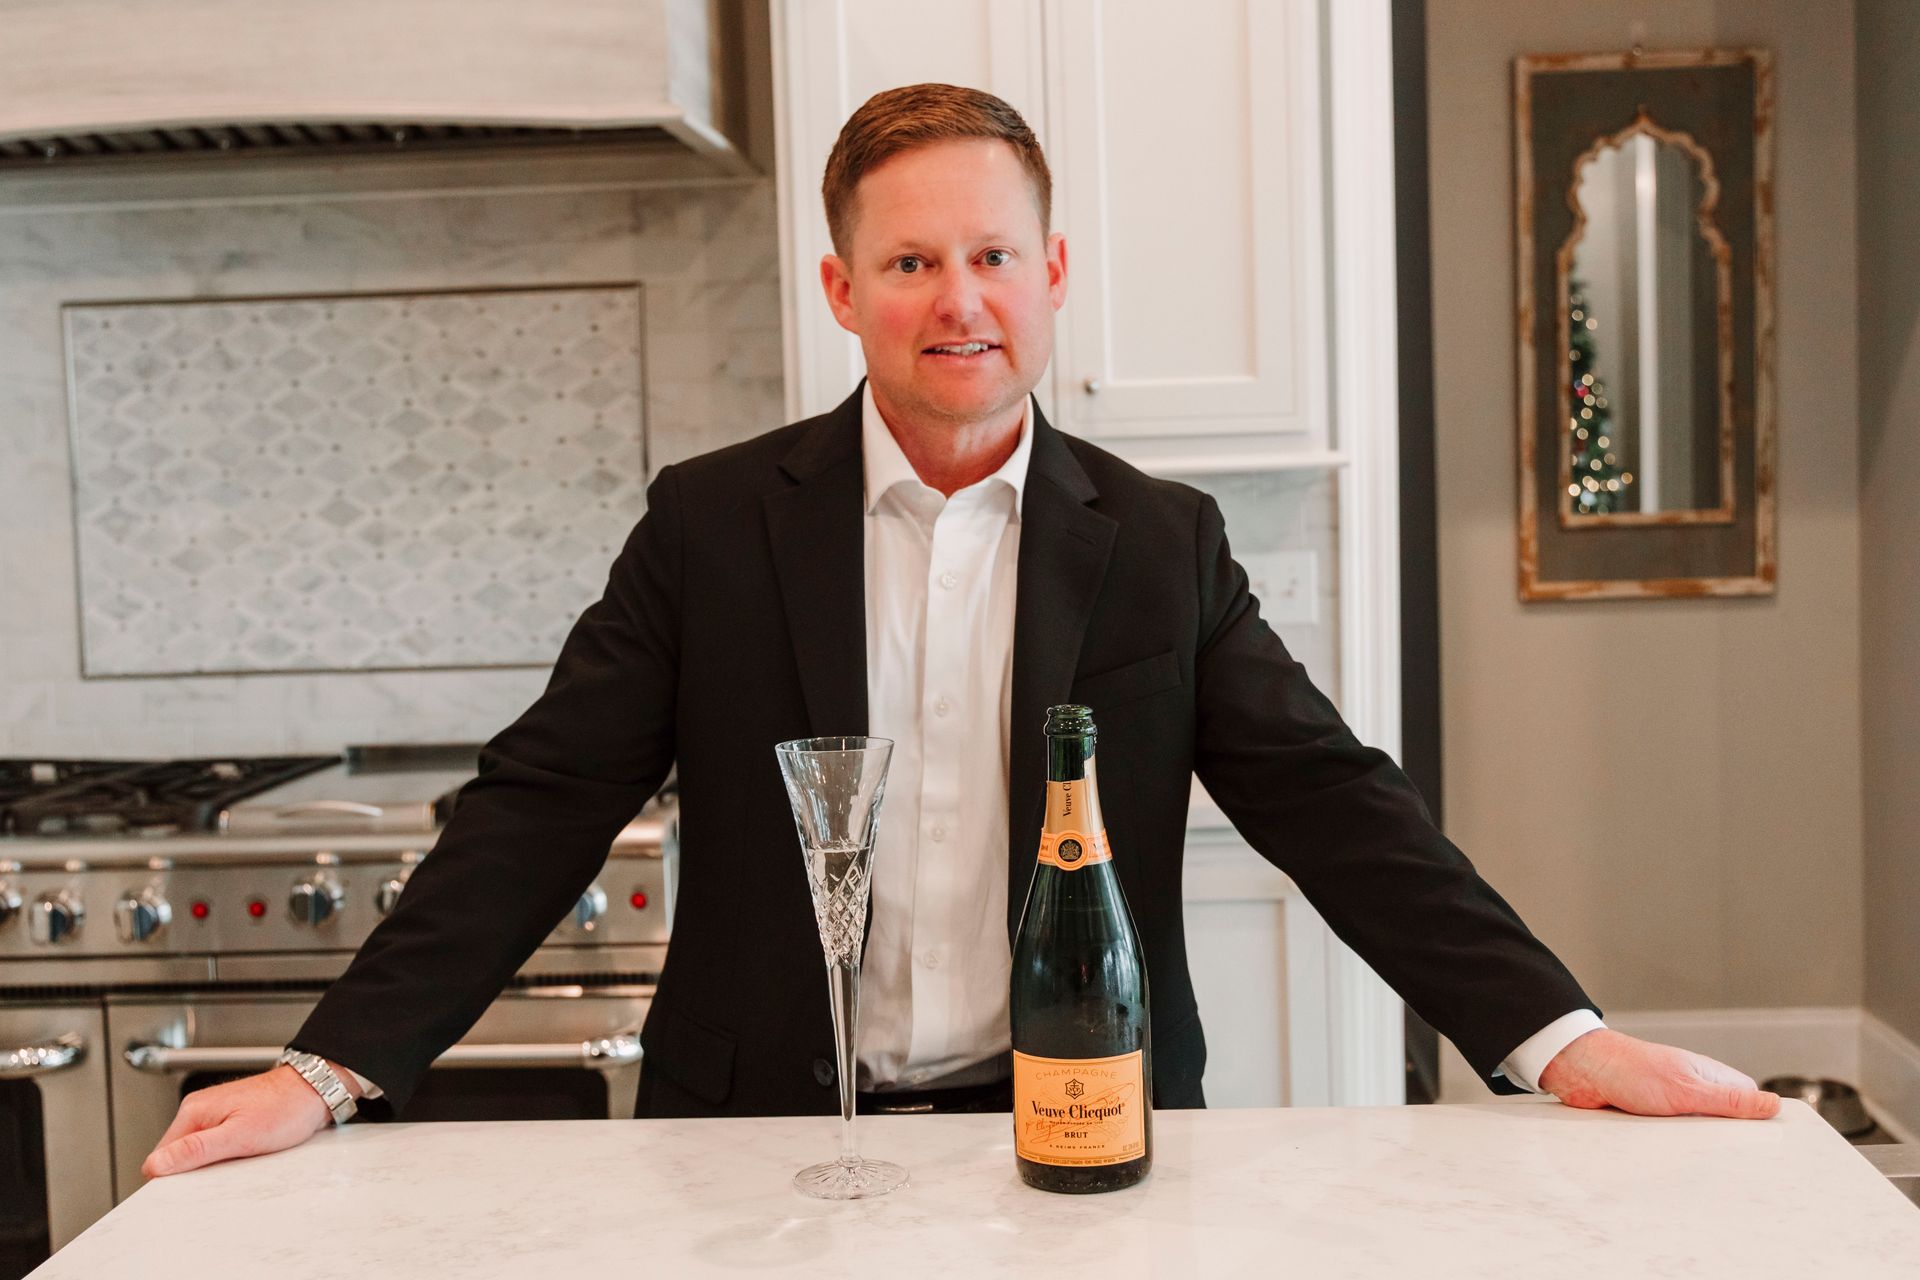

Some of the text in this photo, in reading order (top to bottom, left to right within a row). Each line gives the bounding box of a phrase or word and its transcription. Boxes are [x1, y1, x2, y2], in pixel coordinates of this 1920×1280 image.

[1063, 792, 1072, 817] Veuve
[1035, 1067, 1119, 1080] CHAMPAGNE
[1032, 1100, 1122, 1120] Veuve Clicquot
[1064, 1131, 1088, 1139] BRUT
